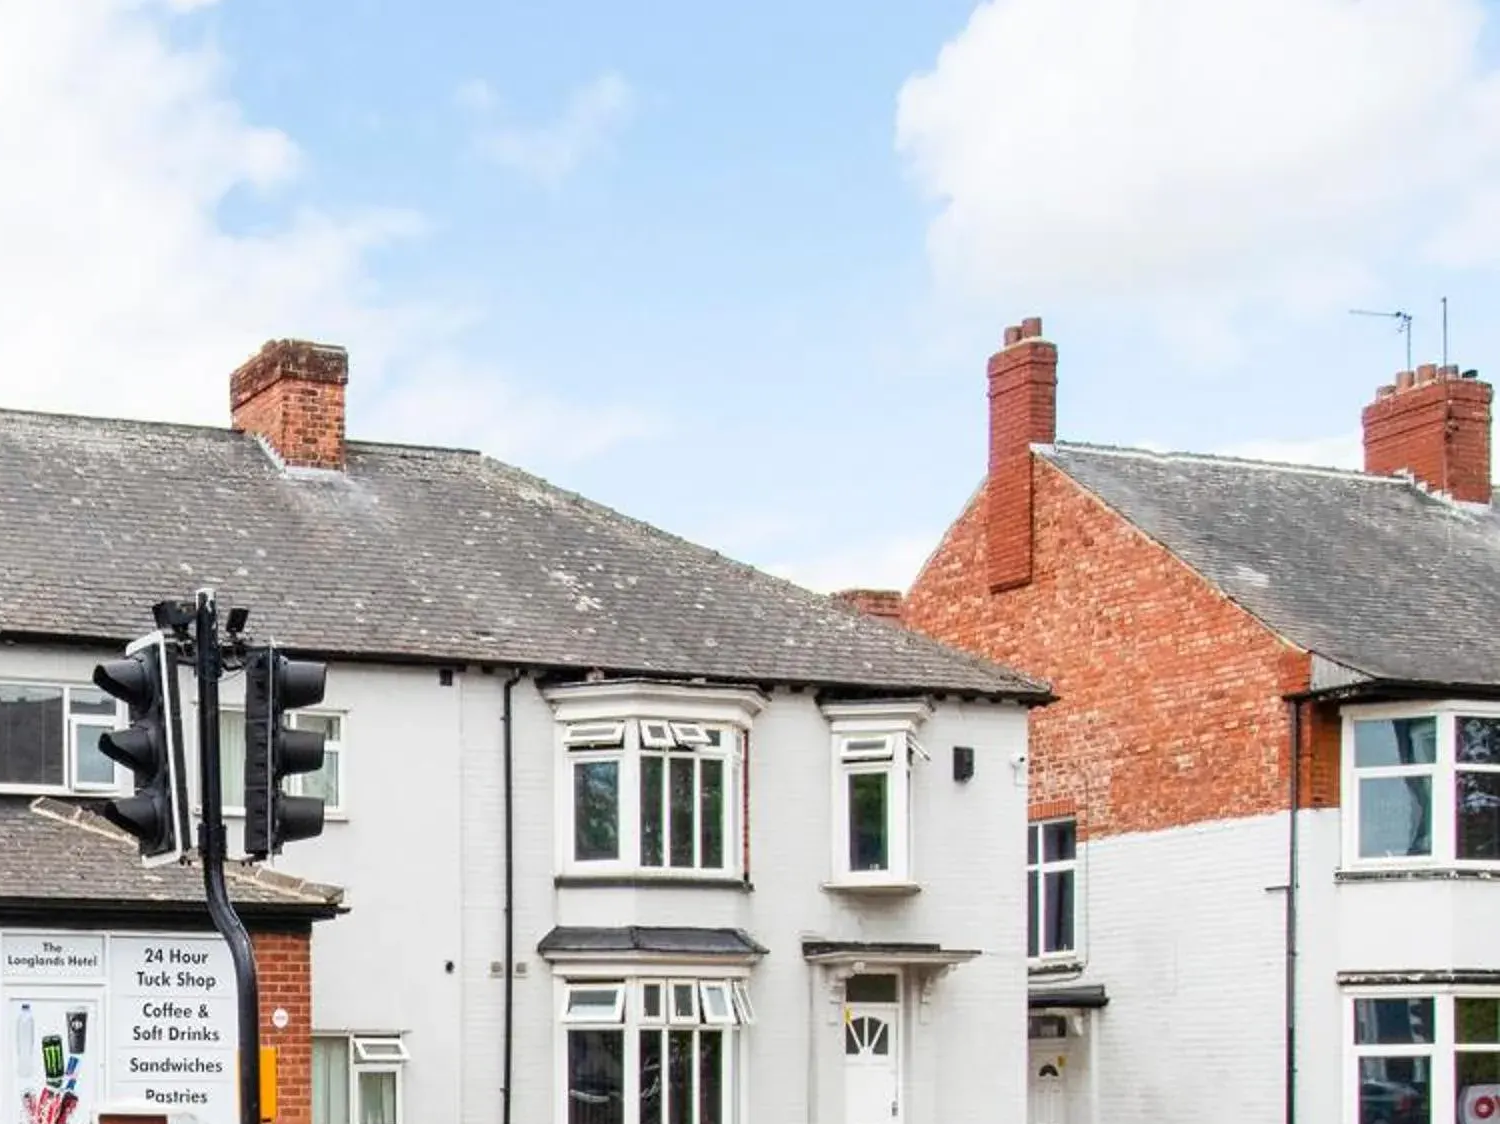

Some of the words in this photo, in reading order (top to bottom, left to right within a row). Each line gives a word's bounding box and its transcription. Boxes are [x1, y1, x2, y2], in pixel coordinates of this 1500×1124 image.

[42, 942, 62, 953] The
[7, 955, 65, 968] Longlands
[67, 955, 97, 967] Hotel
[145, 948, 164, 963] 24
[169, 949, 209, 964] Hour
[137, 971, 171, 987] Tuck
[177, 972, 217, 991] Shop
[142, 1002, 193, 1018] Coffee
[197, 1004, 209, 1018] &
[132, 1026, 163, 1041] Soft
[169, 1026, 221, 1041] Drinks
[129, 1057, 223, 1073] Sandwiches
[145, 1089, 208, 1104] Pastries
